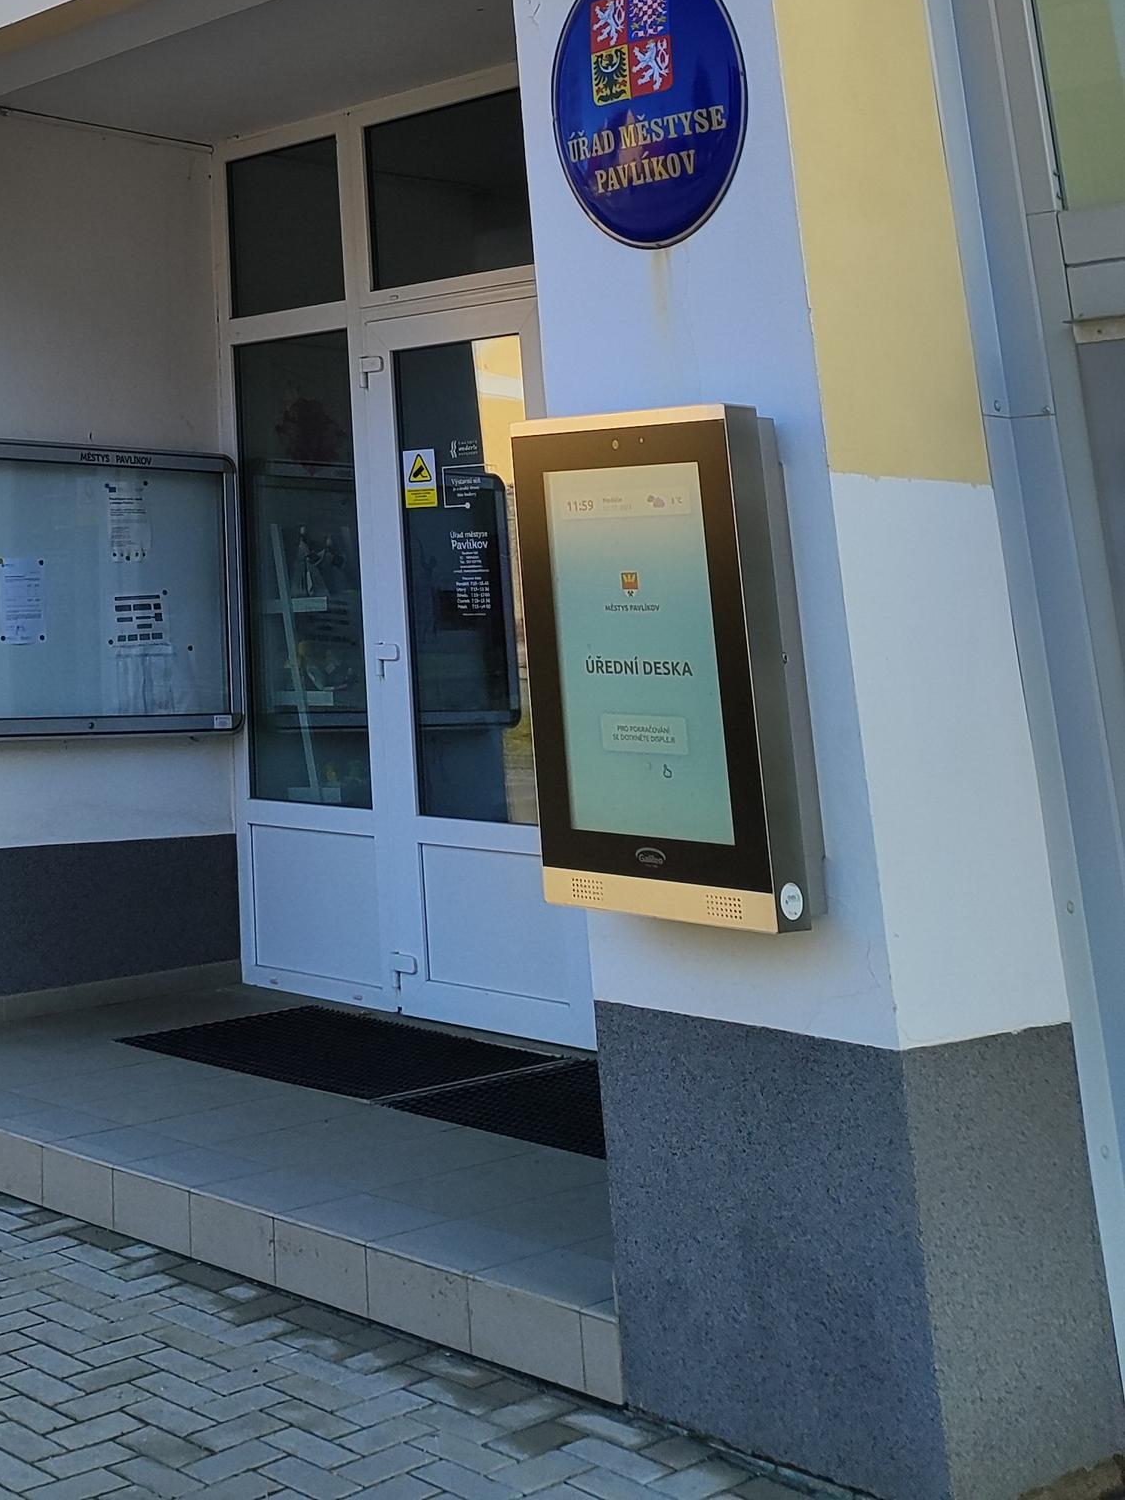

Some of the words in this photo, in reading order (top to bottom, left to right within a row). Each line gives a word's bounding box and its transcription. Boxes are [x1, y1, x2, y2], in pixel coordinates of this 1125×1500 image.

[567, 130, 615, 163] ÚŘAD
[619, 105, 728, 150] MĚSTYSE
[594, 150, 697, 194] PAVLÍKOV
[451, 539, 488, 550] Pavlíkov
[605, 603, 629, 612] MĚSTYS
[630, 603, 660, 612] PAVLÍKOV
[585, 655, 638, 675] ÚŘEDNÍ
[643, 661, 693, 677] DESKA
